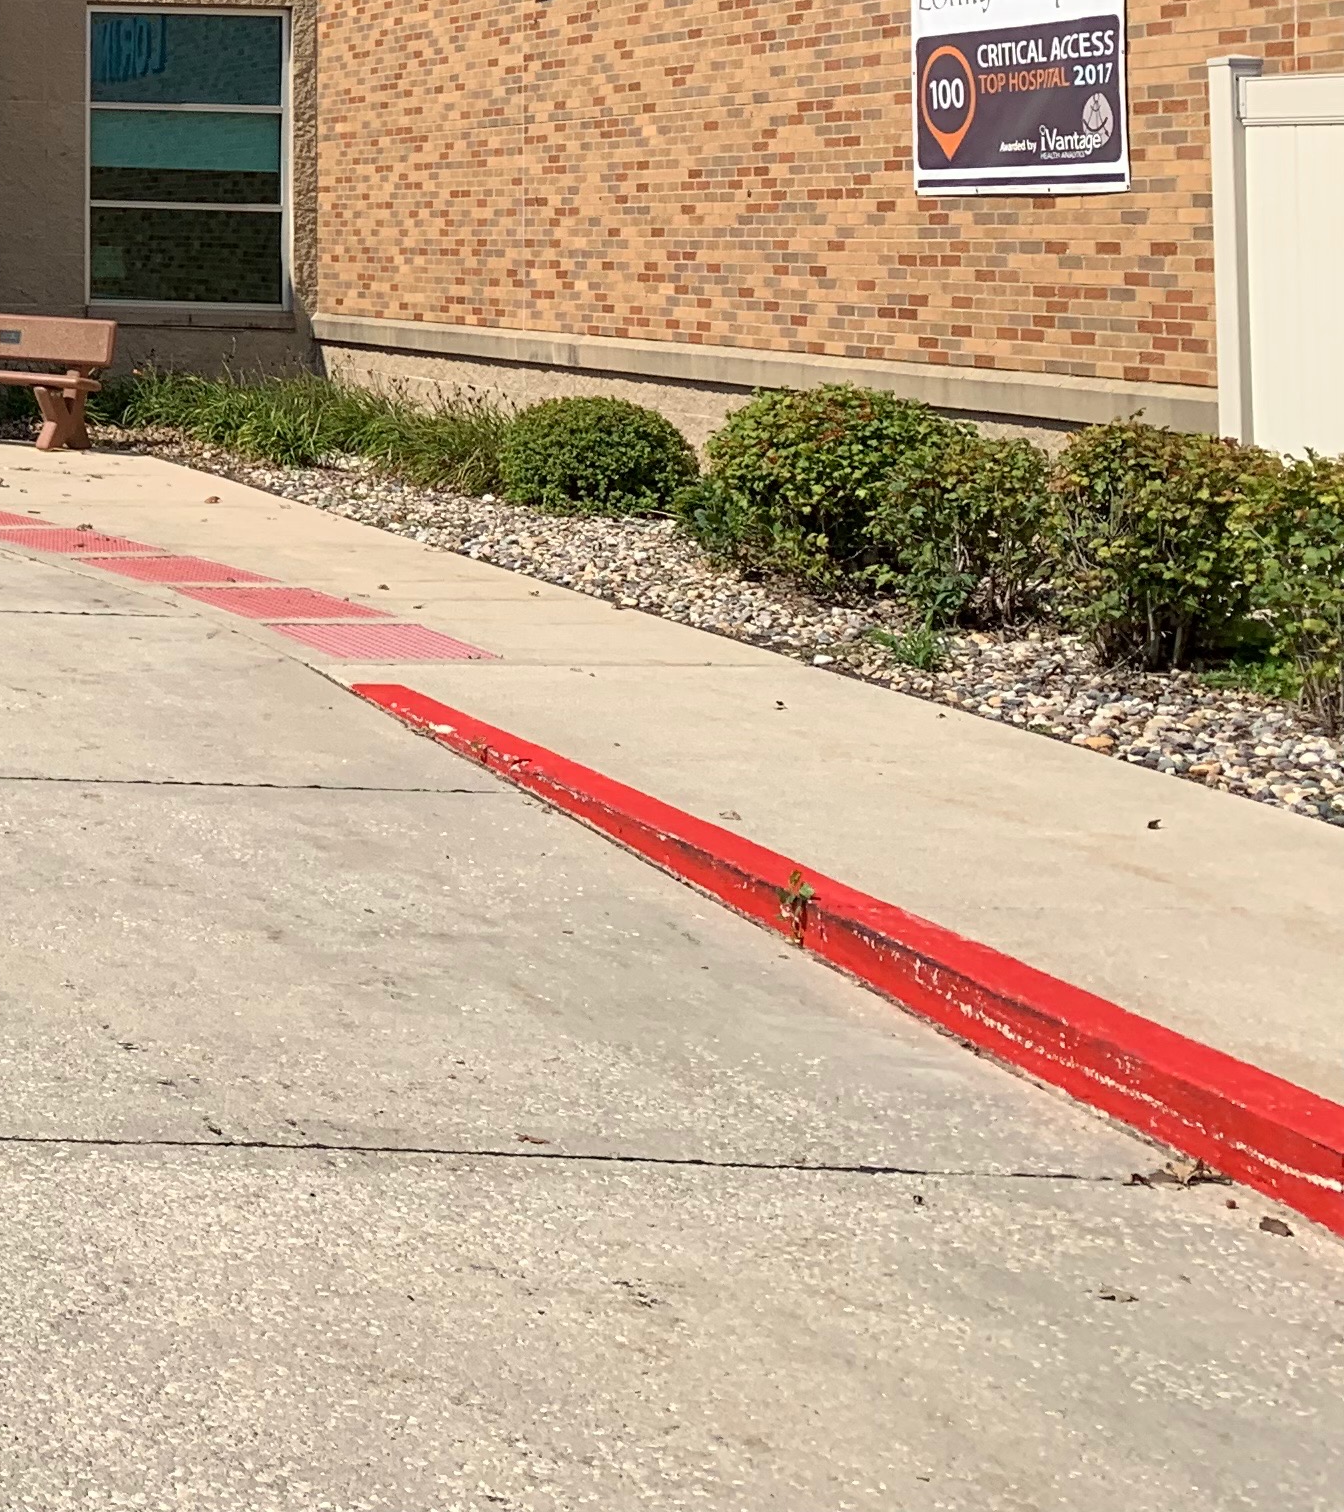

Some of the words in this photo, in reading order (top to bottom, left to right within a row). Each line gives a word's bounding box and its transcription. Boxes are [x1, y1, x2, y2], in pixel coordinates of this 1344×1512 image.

[977, 39, 1047, 68] CRITICAL
[1050, 29, 1114, 61] ACCESS
[929, 78, 964, 110] 100
[978, 73, 1006, 94] TOP
[1009, 66, 1070, 92] HOSPITAL
[1073, 62, 1113, 86] 2017
[999, 139, 1026, 152] Awarded
[1026, 139, 1037, 154] by
[1039, 124, 1102, 155] iVantage
